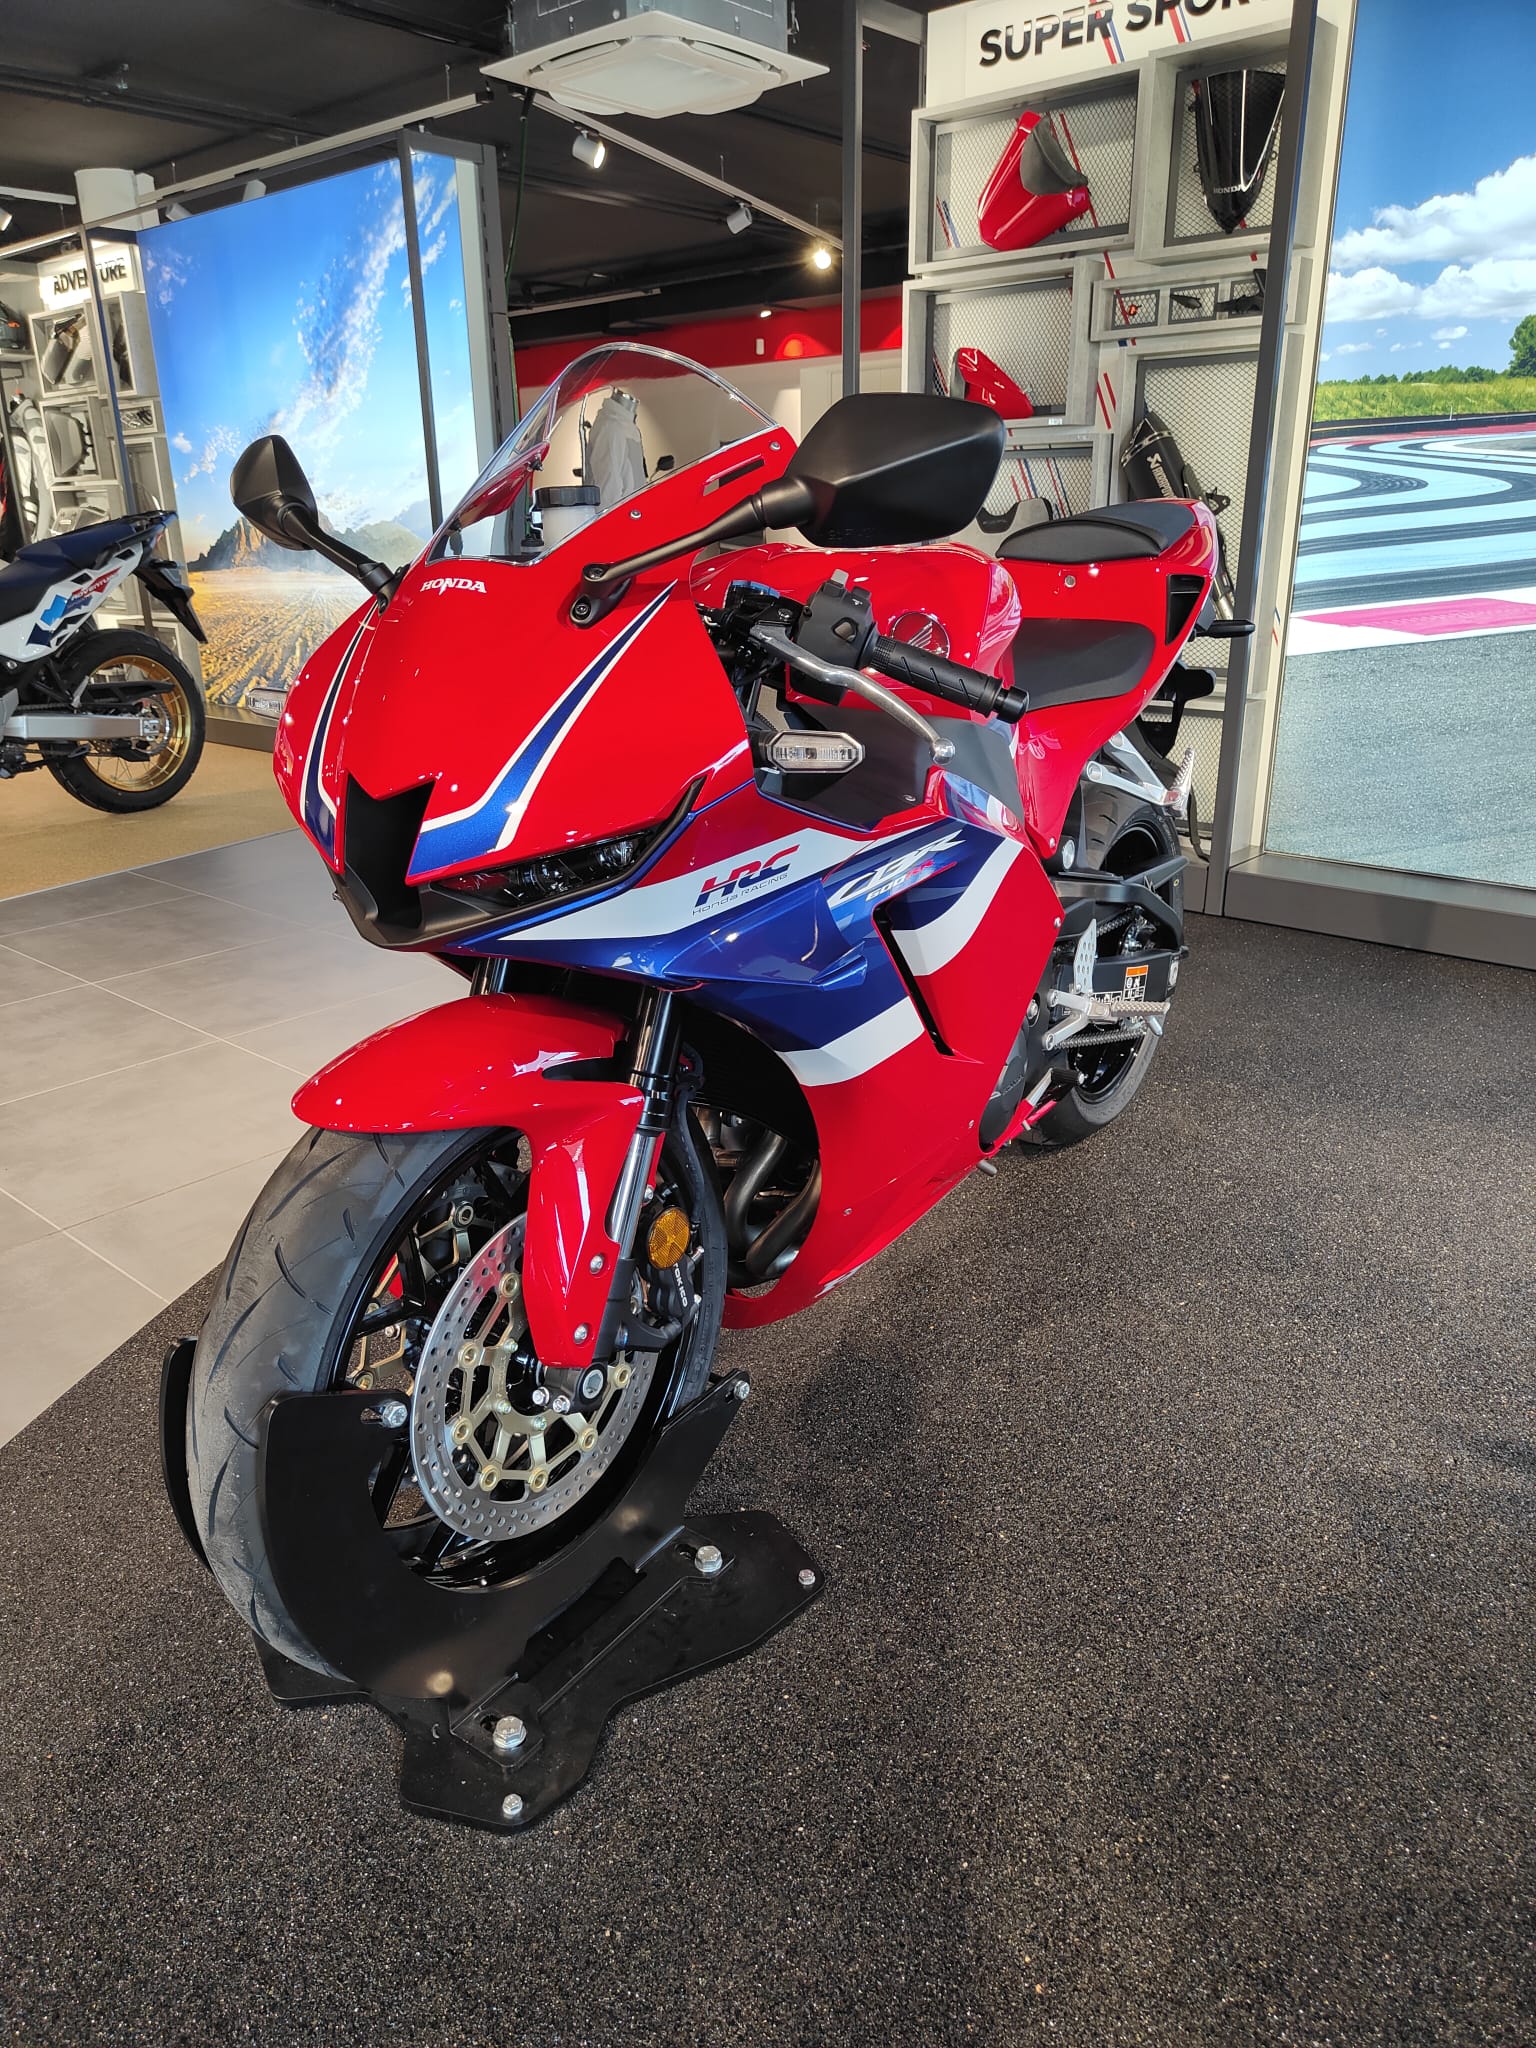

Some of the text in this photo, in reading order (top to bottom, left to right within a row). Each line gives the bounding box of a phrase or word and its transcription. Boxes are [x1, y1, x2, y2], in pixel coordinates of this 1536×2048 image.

[979, 3, 1113, 66] SUPER
[420, 578, 487, 595] HONDA
[692, 872, 788, 916] Honda RACING
[695, 844, 800, 907] HRC
[827, 829, 966, 908] CBR
